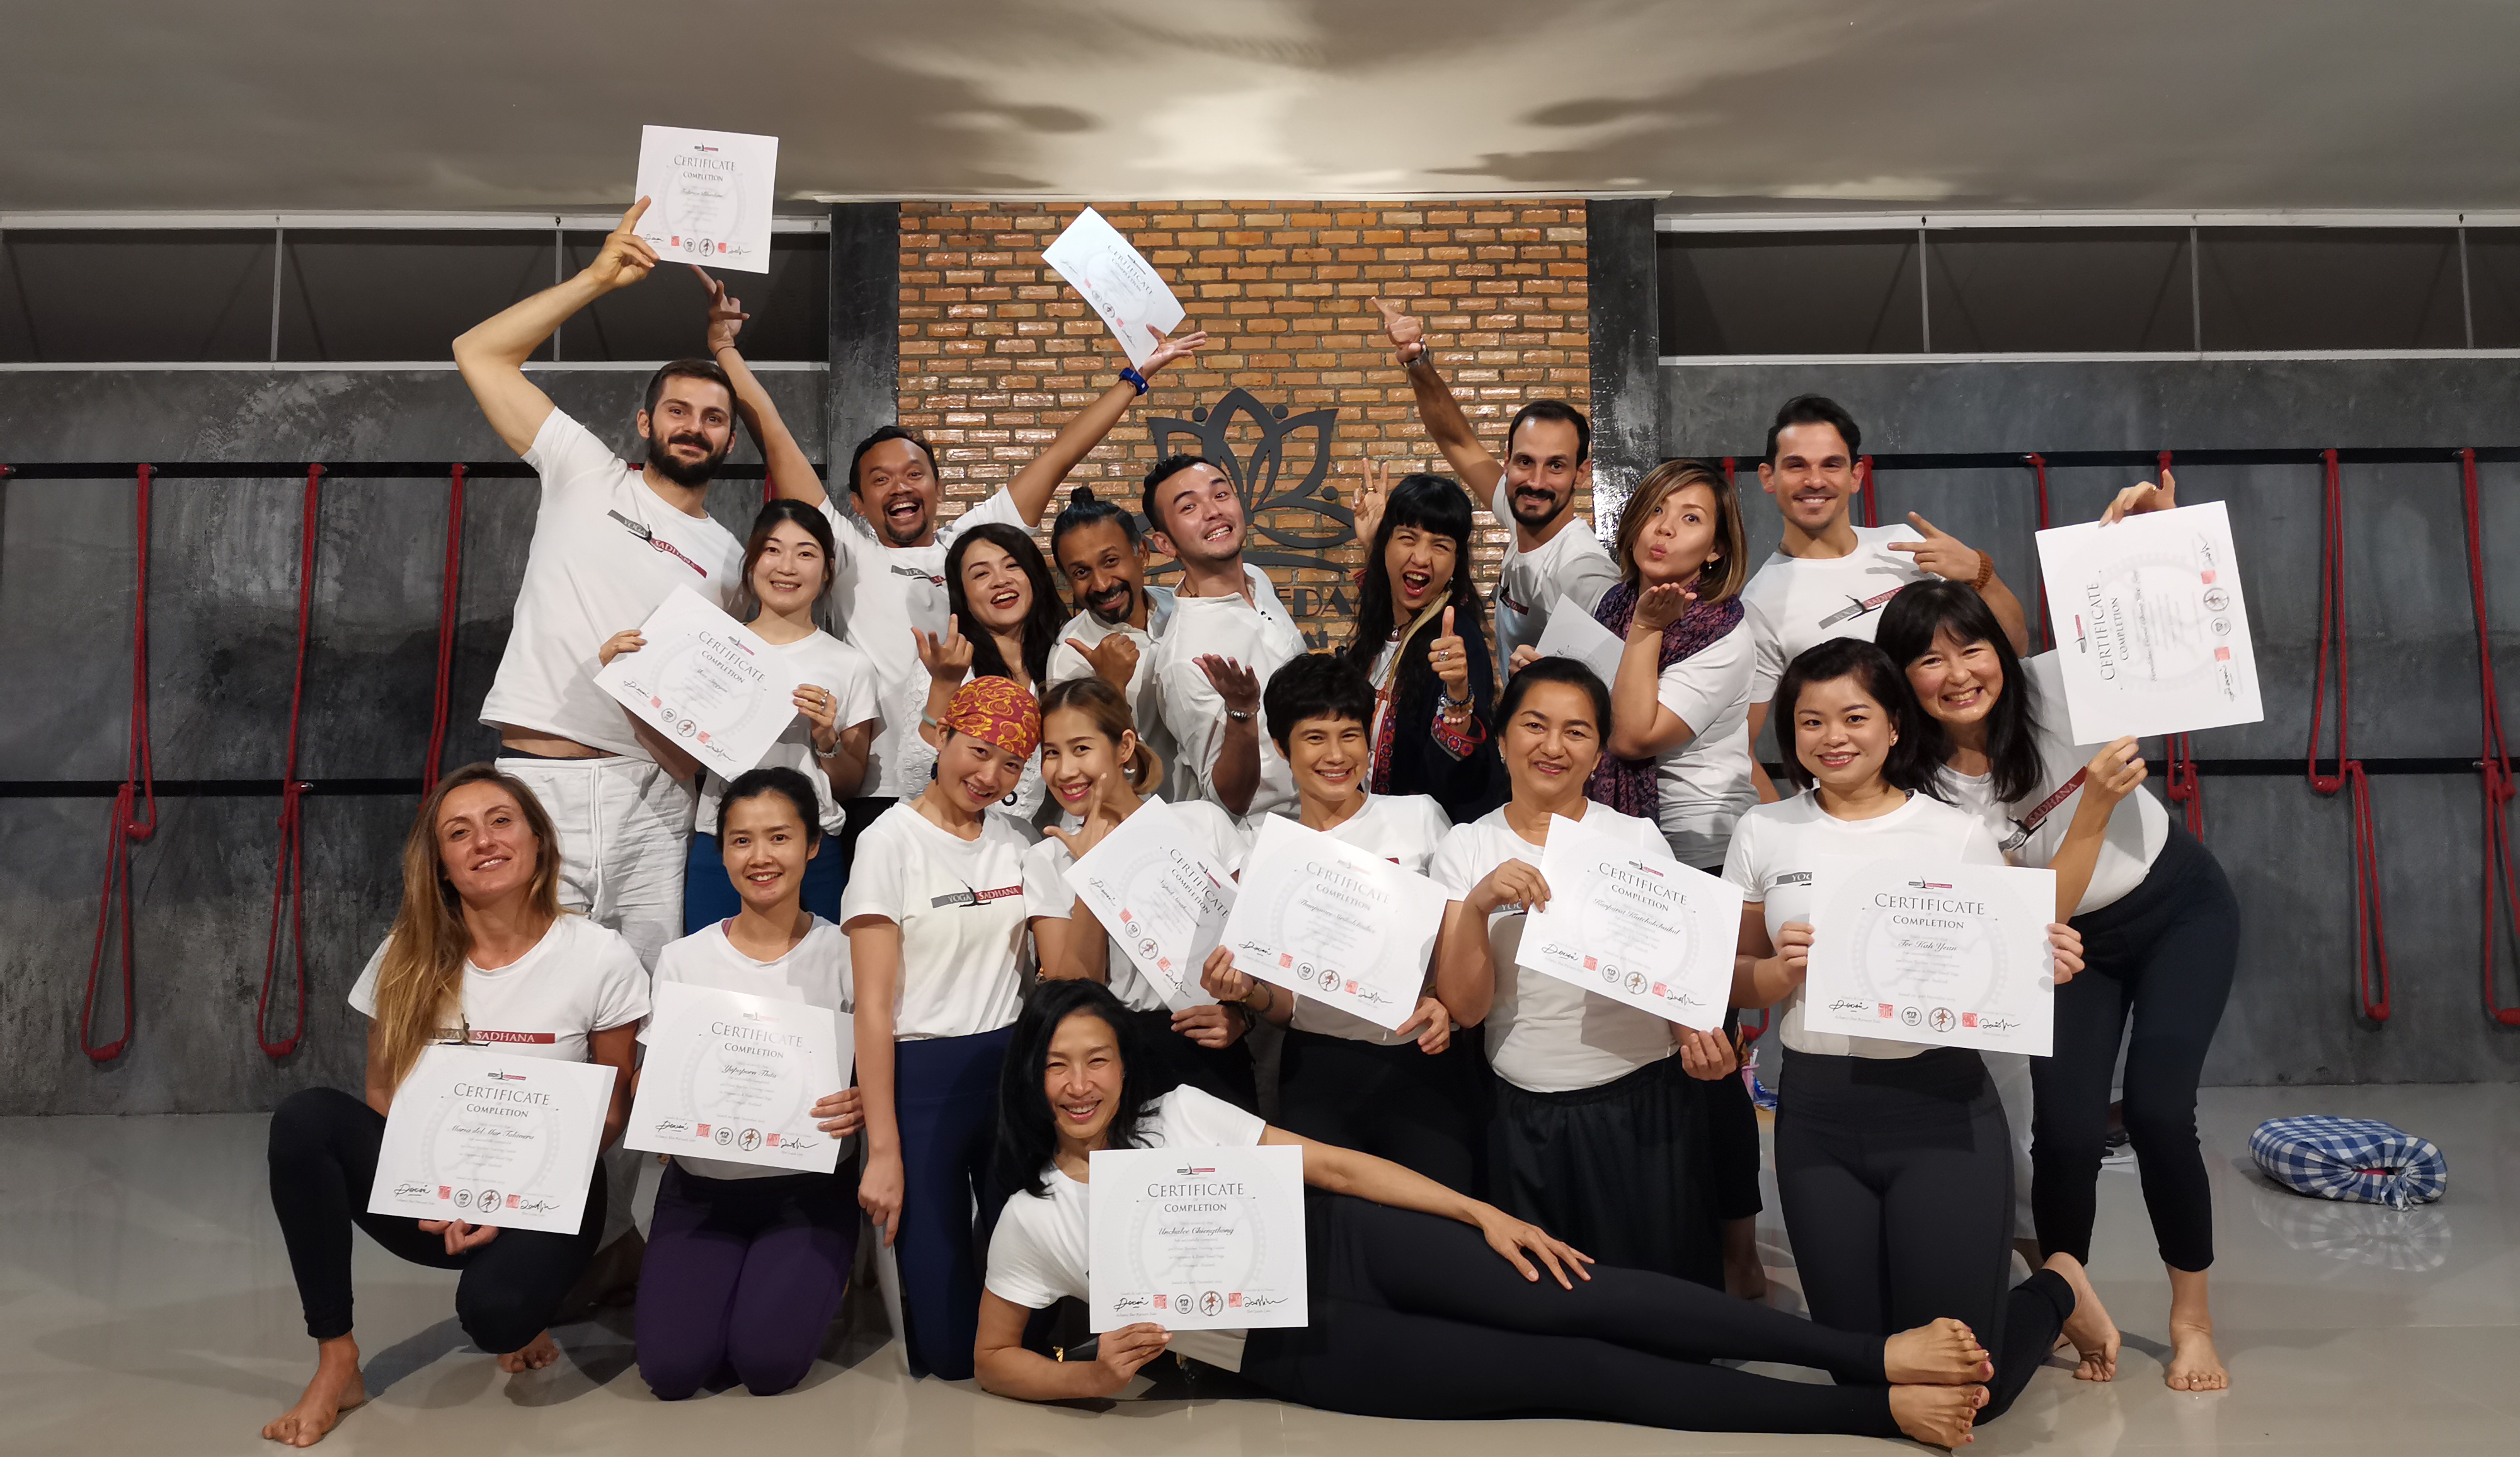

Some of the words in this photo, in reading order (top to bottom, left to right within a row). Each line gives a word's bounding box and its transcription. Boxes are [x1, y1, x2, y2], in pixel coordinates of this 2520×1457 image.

[674, 155, 735, 171] CERTIFICATE
[683, 171, 723, 182] COMPLETION
[624, 519, 646, 536] YOGA
[2087, 583, 2116, 681] CERTIFICATE
[2112, 597, 2129, 661] COMPLETION
[699, 631, 765, 682] CERTIFICATE
[702, 650, 745, 683] COMPLETION
[2030, 783, 2078, 823] SADHANA
[948, 894, 971, 903] YOGA
[978, 887, 1019, 900] SADHANA
[1170, 849, 1230, 919] CERTIFICATE
[1172, 868, 1211, 914] COMPLETION
[1305, 861, 1391, 904] CERTIFICATE
[1599, 862, 1688, 906] CERTIFICATE
[1315, 884, 1371, 912] COMPLETION
[1612, 884, 1669, 913] COMPLETION
[1874, 892, 1985, 916] CERTIFICATE
[1893, 914, 1964, 930] COMPLETION
[476, 1031, 536, 1043] SADHANA
[711, 1022, 803, 1048] CERTIFICATE
[724, 1042, 784, 1059] COMPLETION
[454, 1083, 551, 1105] CERTIFICATE
[466, 1103, 529, 1118] COMPLETION
[1147, 1183, 1244, 1198] CERTIFICATE
[1164, 1203, 1227, 1212] COMPLETION
